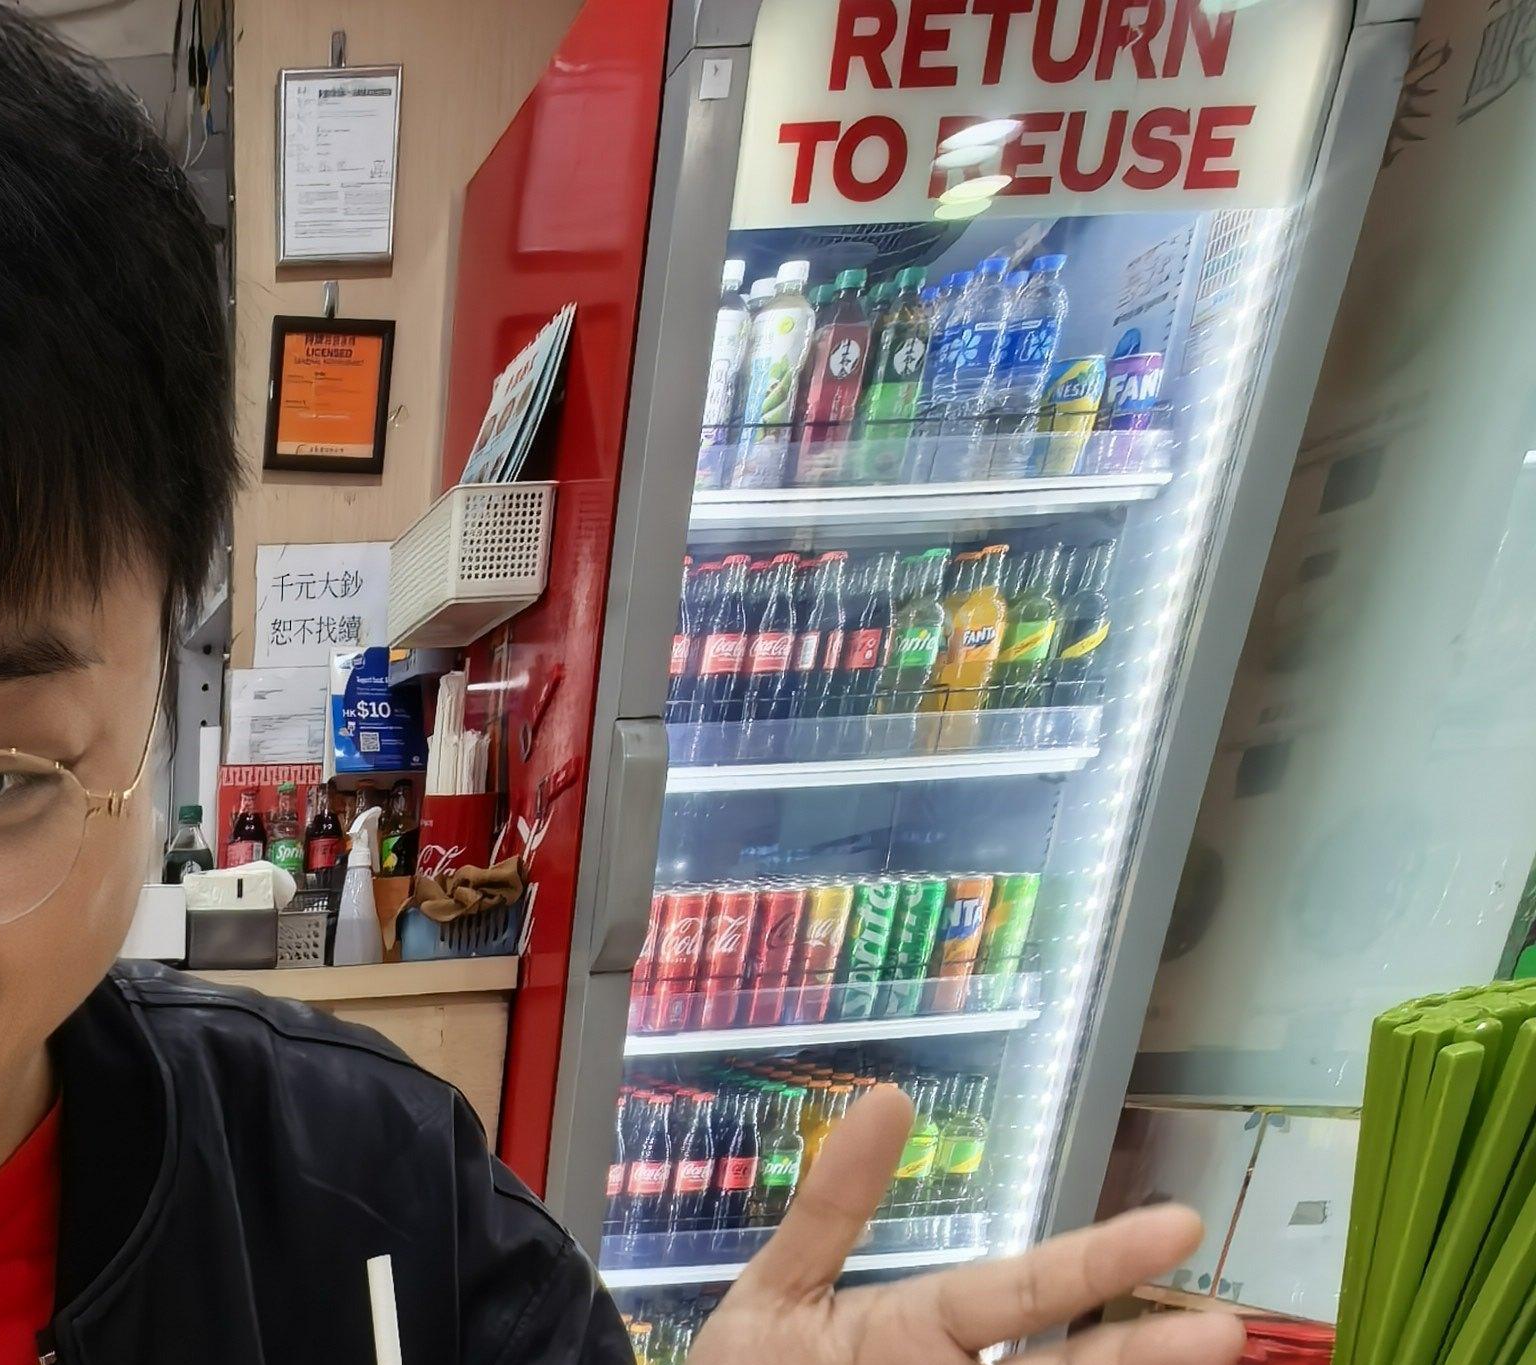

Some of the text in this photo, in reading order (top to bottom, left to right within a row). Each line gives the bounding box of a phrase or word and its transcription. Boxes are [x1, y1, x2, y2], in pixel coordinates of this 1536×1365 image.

[828, 0, 1237, 92] RETURN
[778, 115, 908, 205] TO
[272, 570, 363, 602] 千元大鈔
[270, 615, 362, 647] 恕不找續
